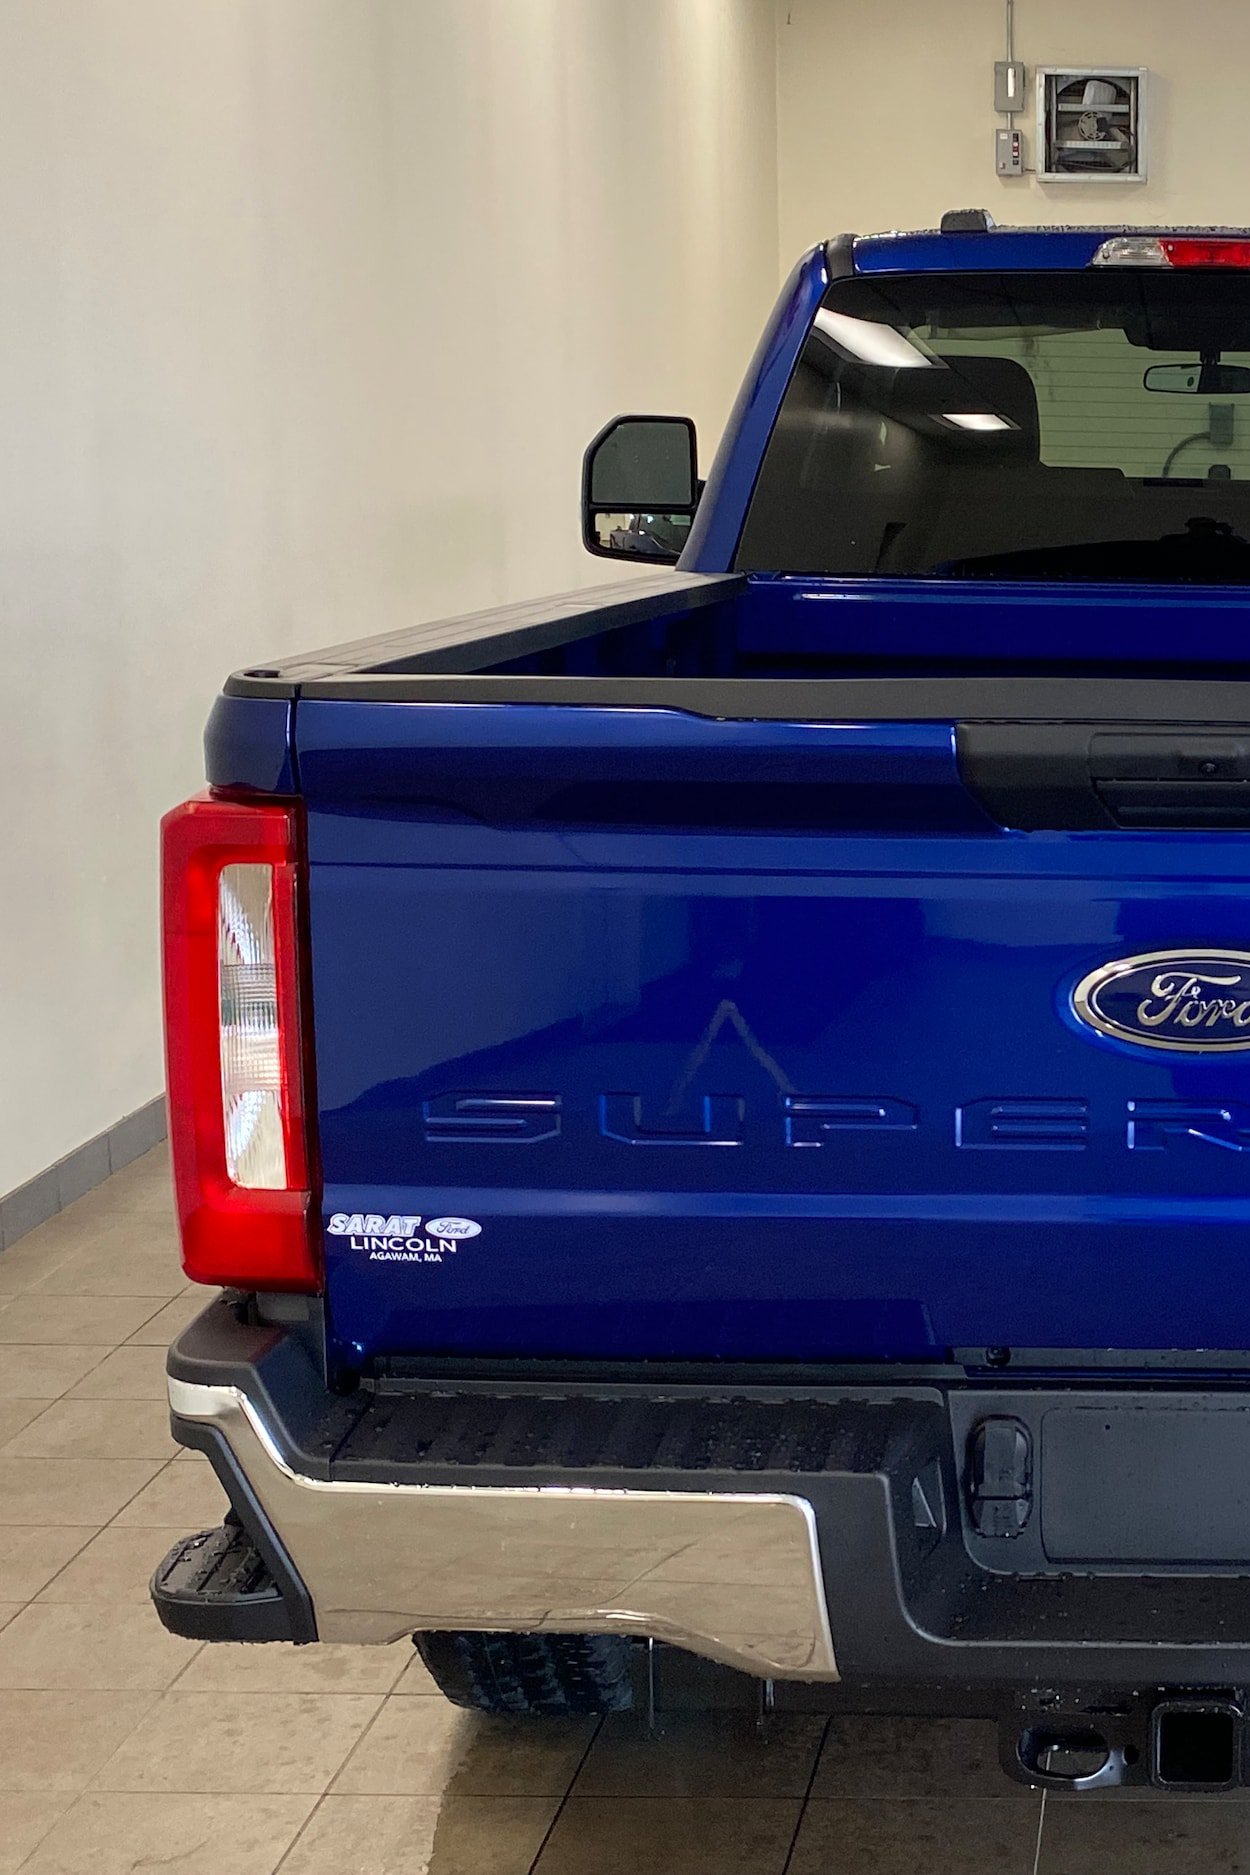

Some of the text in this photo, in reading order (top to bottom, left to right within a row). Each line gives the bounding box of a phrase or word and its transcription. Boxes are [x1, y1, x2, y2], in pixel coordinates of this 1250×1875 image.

[328, 1213, 470, 1237] SARAT Ford
[350, 1236, 457, 1252] LINCOLN
[369, 1252, 442, 1262] AGAWAM, MA
